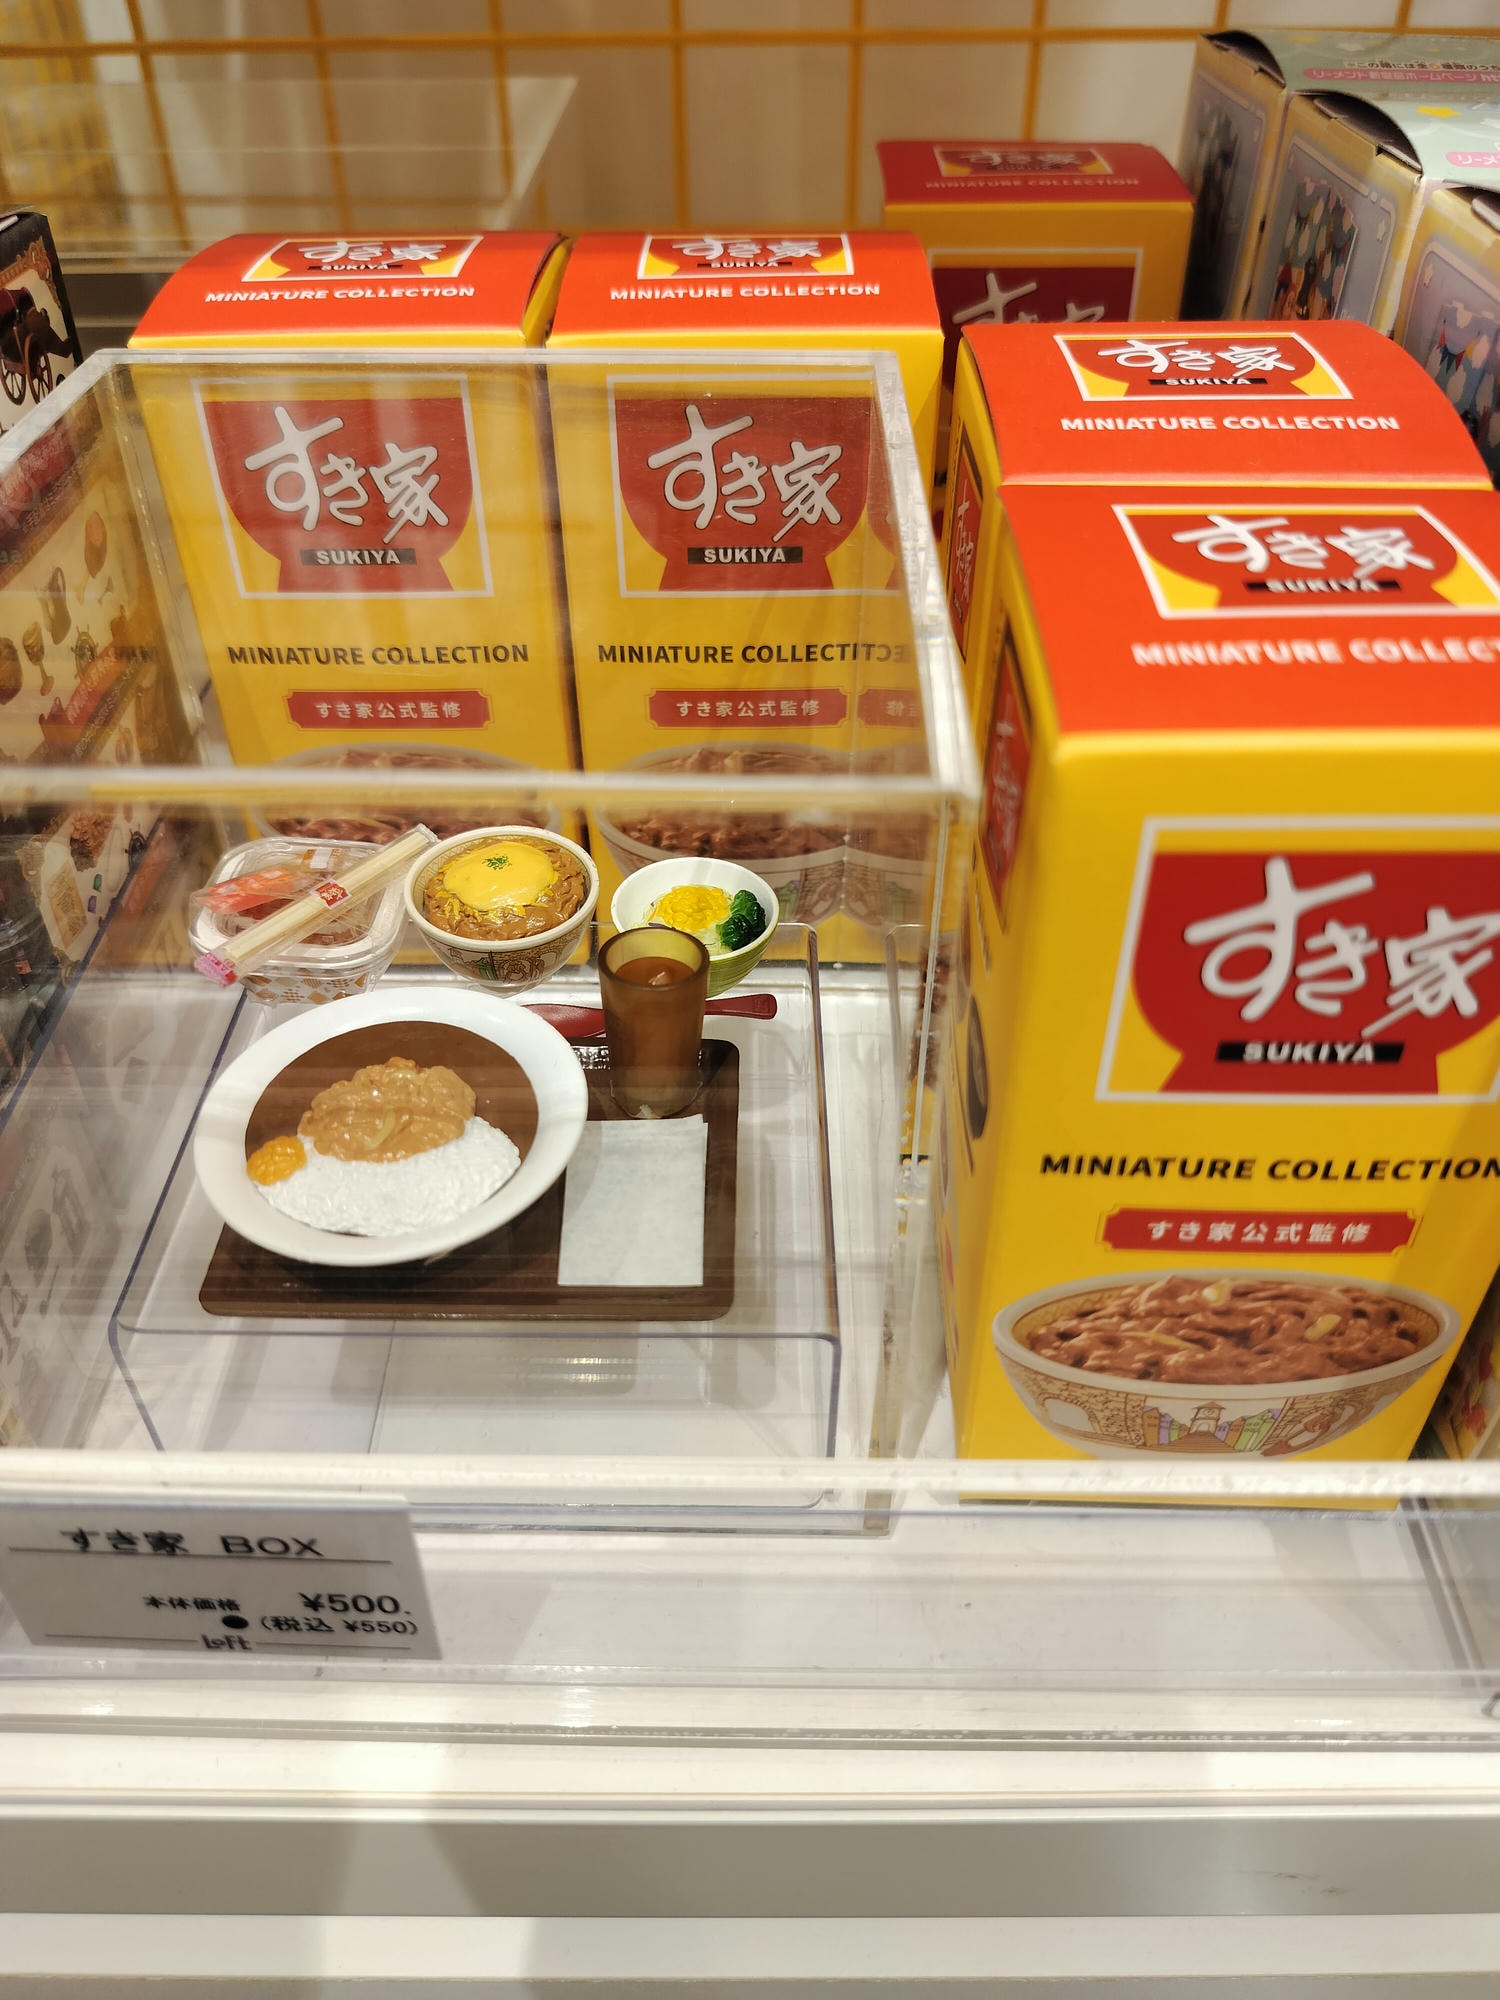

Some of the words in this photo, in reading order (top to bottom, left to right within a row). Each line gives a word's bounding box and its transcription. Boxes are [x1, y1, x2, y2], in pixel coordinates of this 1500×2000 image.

[321, 263, 390, 271] SUKIYA
[711, 260, 780, 269] SUKIYA
[205, 288, 329, 302] MINIATURE
[334, 286, 475, 299] COLLECTION
[610, 286, 734, 300] MINIATURE
[740, 283, 880, 298] COLLECTION
[1098, 339, 1297, 378] すき家
[1165, 376, 1252, 386] SUKIYA
[1060, 416, 1217, 431] MINIATURE
[1222, 415, 1400, 431] COLLECTION
[244, 405, 449, 545] すき家
[647, 403, 844, 543] すき家
[1171, 512, 1436, 578] すき家
[316, 549, 401, 565] SUKIYA
[703, 547, 787, 564] SUKIYA
[1265, 578, 1381, 593] SUKIYA
[226, 645, 365, 666] MINIATURE
[371, 643, 530, 666] COLLECTION
[598, 643, 734, 664] MINIATURE
[1130, 638, 1344, 667] MINIATURE
[315, 701, 463, 719] すき家公式監修
[676, 699, 821, 718] すき家公式監修
[1182, 854, 1500, 1040] すき家
[1242, 1041, 1376, 1064] SUKIYA
[1039, 1153, 1257, 1181] MINIATURE
[1147, 1220, 1373, 1245] すき家公式監修
[60, 1528, 189, 1555] すき家
[219, 1534, 324, 1557] BOX
[143, 1595, 241, 1612] 本体価格
